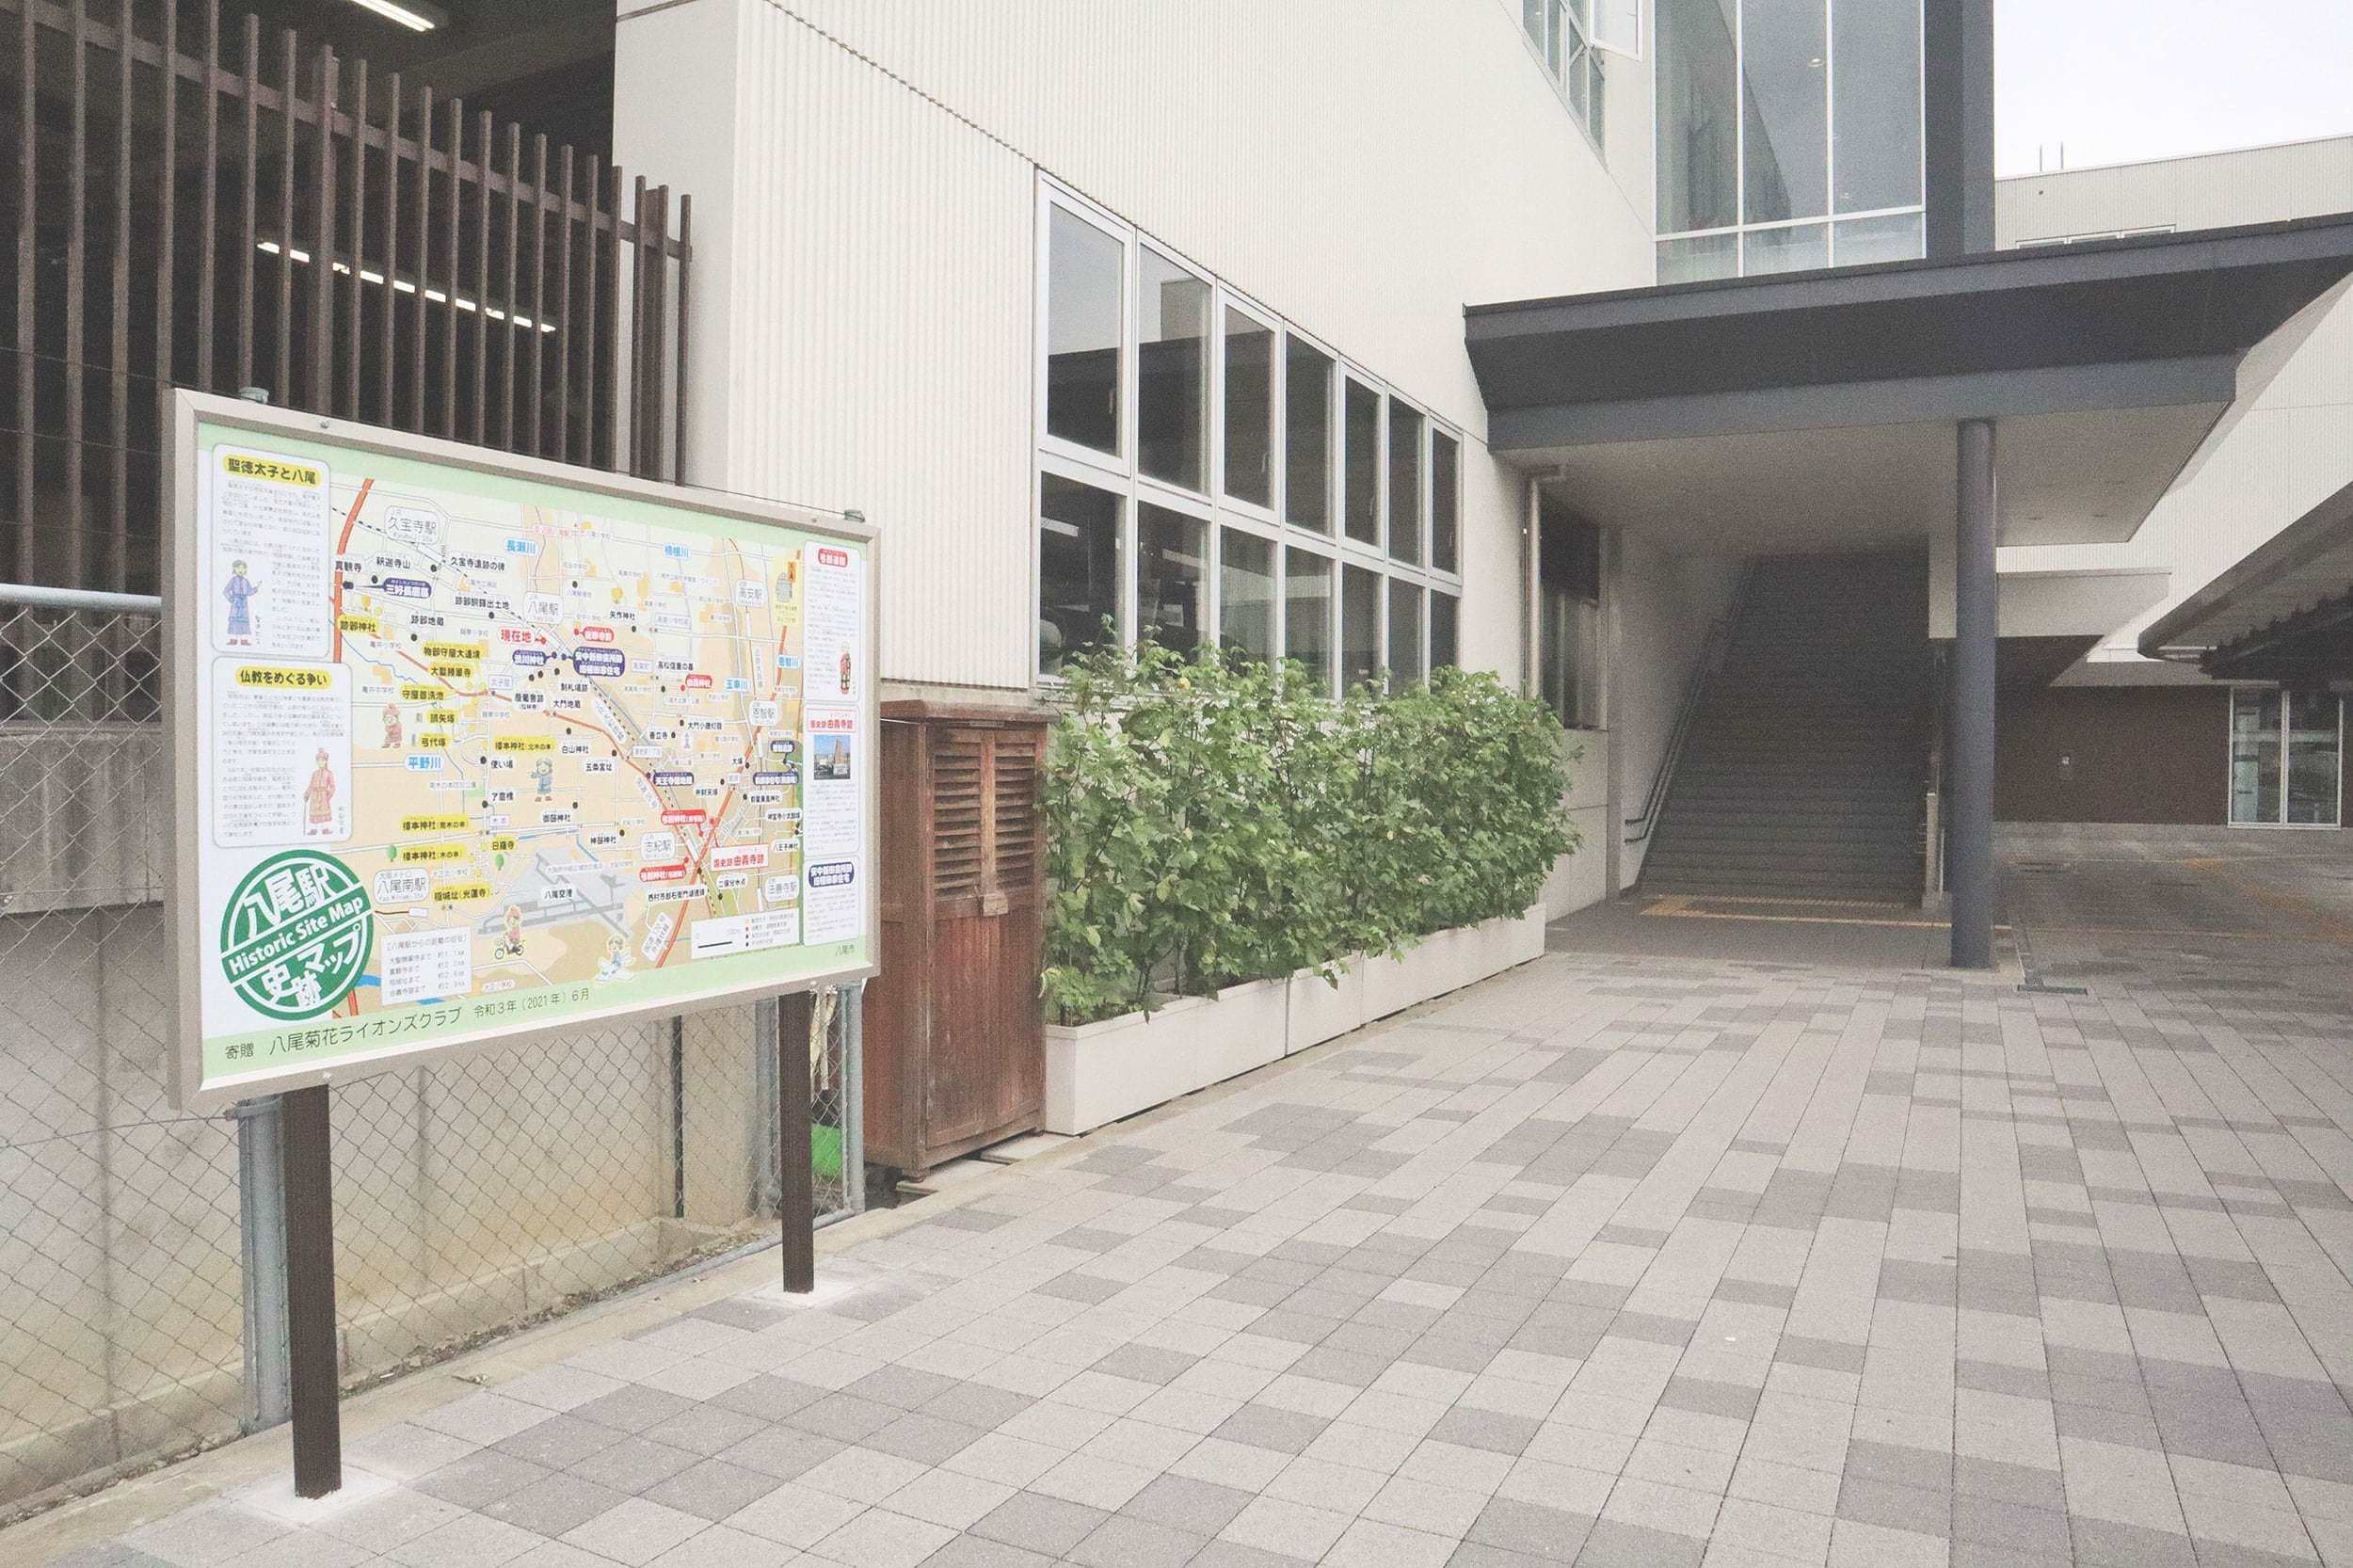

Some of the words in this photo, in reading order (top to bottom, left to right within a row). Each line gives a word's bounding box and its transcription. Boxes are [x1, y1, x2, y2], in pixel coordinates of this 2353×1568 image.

[228, 457, 316, 485] 聖徳太子と八尾
[388, 517, 437, 536] 久宝寺駅
[501, 629, 532, 644] 現在地
[240, 669, 328, 686] 仏教をめぐる争い
[408, 756, 441, 770] 平野川
[376, 877, 426, 895] 八尾南駅
[242, 864, 338, 940] 八尾駅
[228, 932, 296, 975] Historic
[296, 914, 328, 940] Site
[328, 896, 364, 923] Map
[296, 922, 360, 975] マップ
[261, 964, 323, 1007] 史跡
[225, 1043, 255, 1060] 寄贈
[269, 1007, 463, 1055] 八尾菊花ライオンズクラブ
